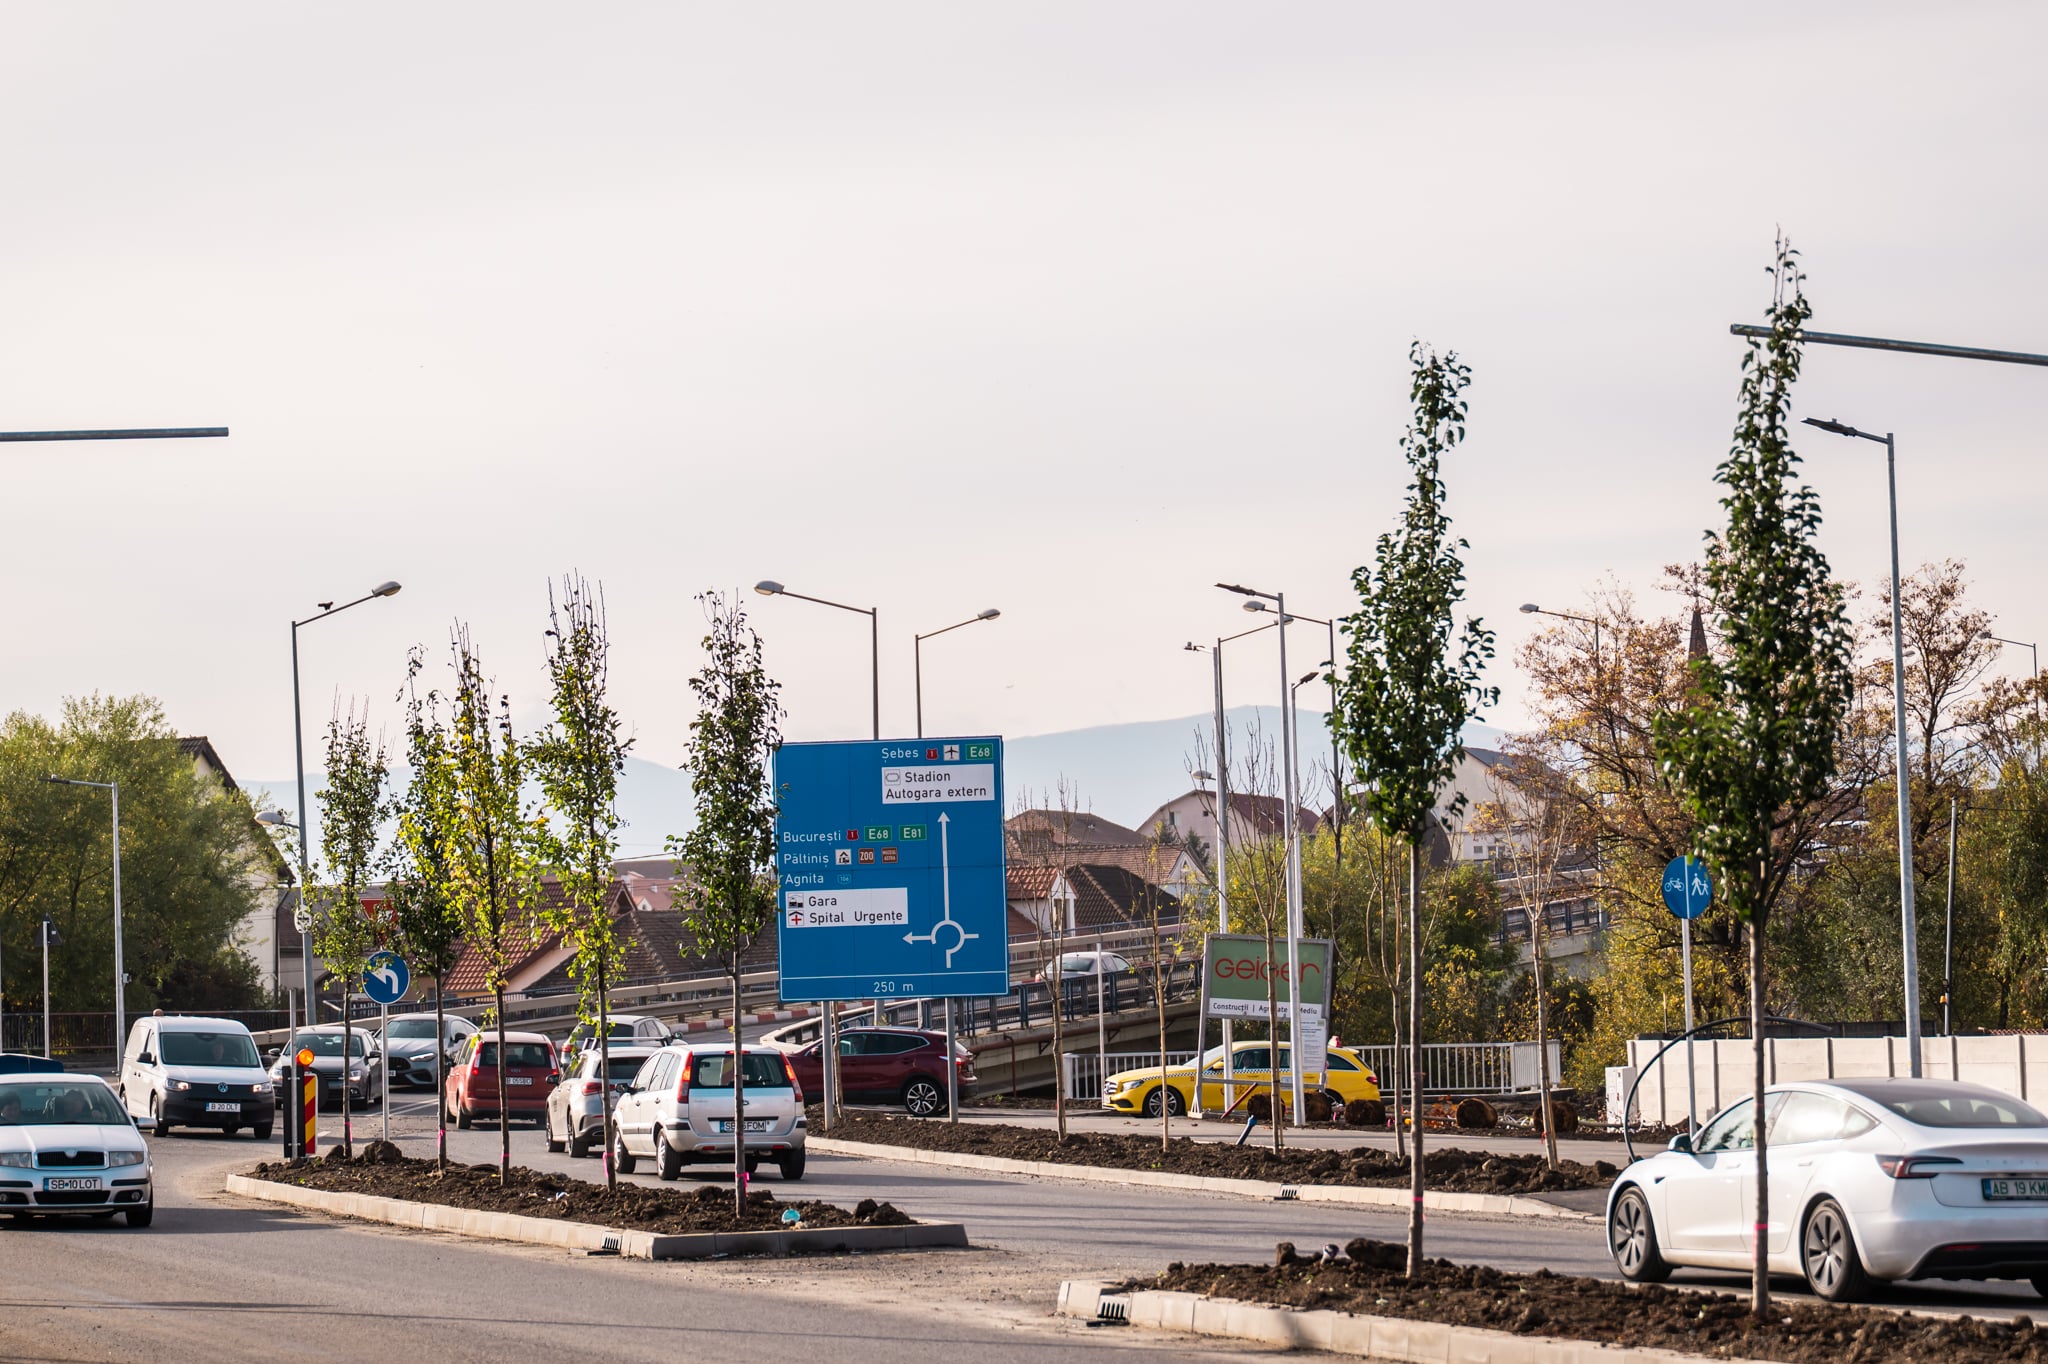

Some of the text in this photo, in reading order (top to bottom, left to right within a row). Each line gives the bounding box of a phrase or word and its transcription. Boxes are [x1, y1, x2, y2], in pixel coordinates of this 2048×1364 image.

[970, 746, 991, 758] E68
[904, 771, 952, 783] Stadion
[885, 786, 987, 801] Autogara extern
[783, 829, 841, 846] București
[868, 828, 889, 840] E68
[903, 827, 922, 839] E81
[859, 851, 874, 861] ZOO
[784, 873, 825, 887] Agnita
[808, 896, 838, 907] Gara
[809, 911, 845, 925] Spital
[873, 981, 914, 993] 250 m
[1993, 1181, 2009, 1195] AB
[2014, 1181, 2026, 1195] 19
